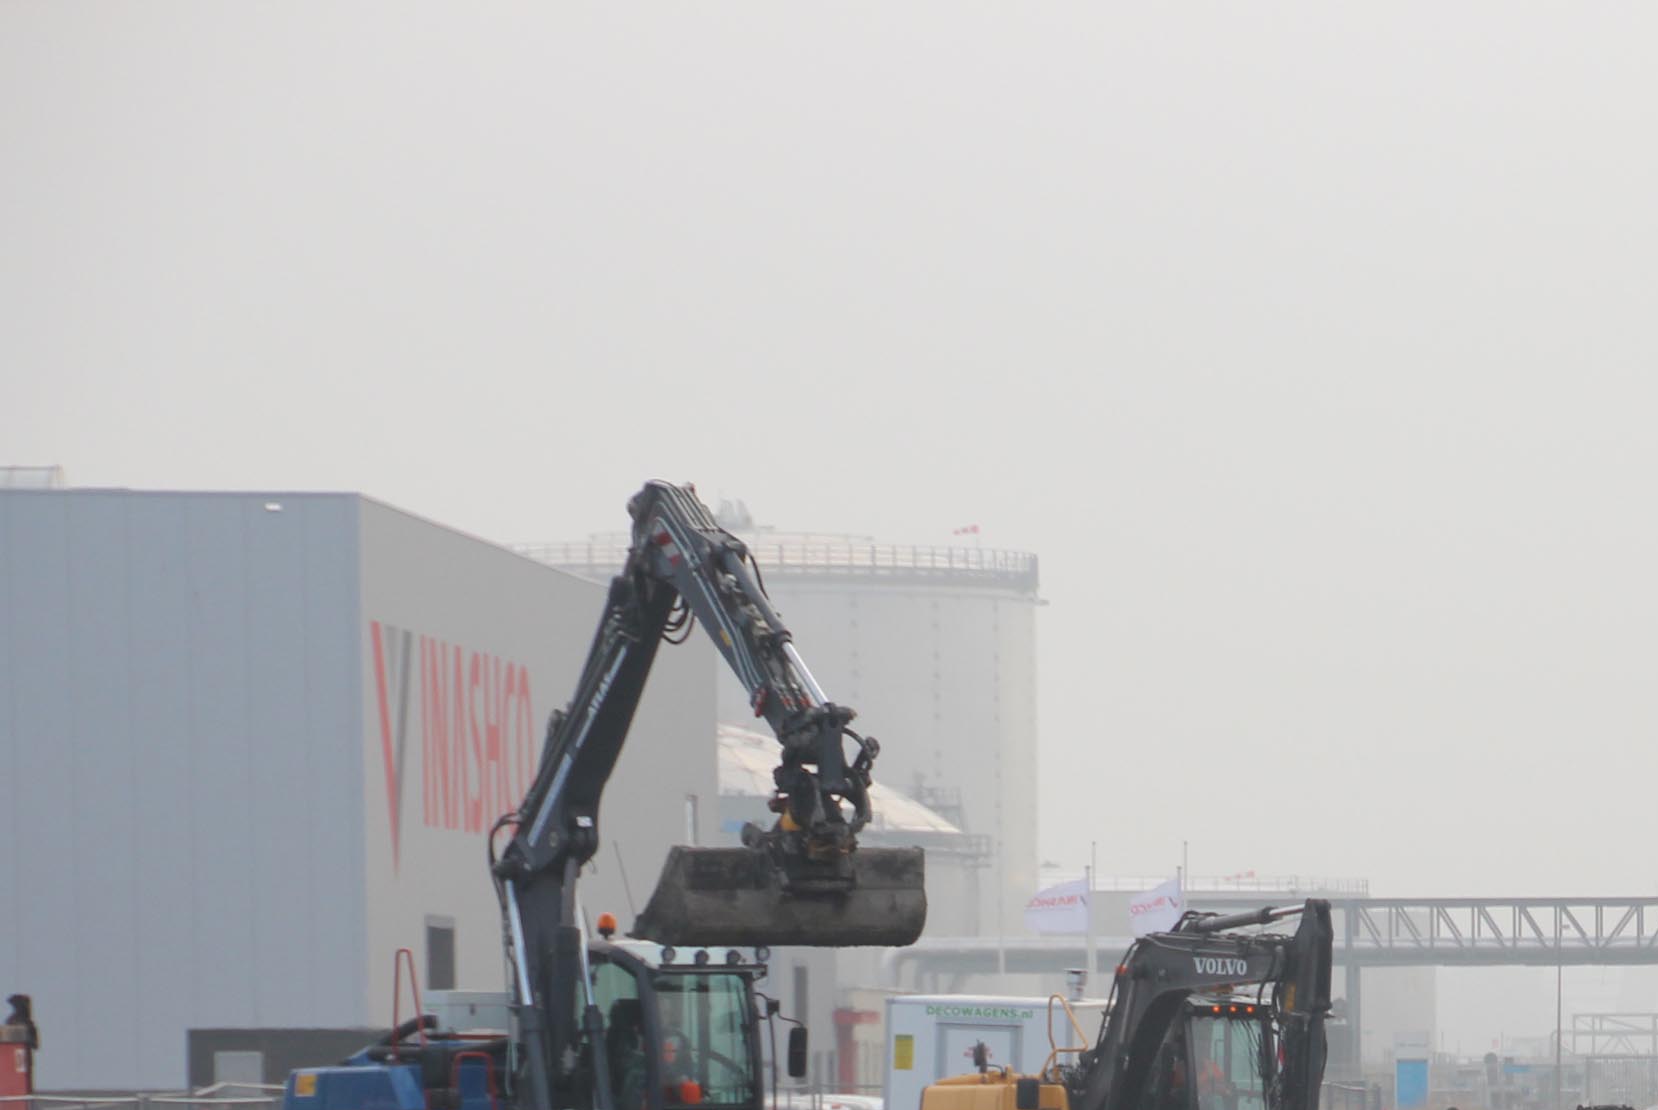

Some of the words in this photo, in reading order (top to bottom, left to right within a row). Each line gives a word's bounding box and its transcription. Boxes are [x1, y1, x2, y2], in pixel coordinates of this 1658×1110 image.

[369, 620, 537, 879] VINASHCO
[1193, 957, 1247, 975] VOLVO
[926, 1006, 1033, 1018] DECOWAGENS.nl
